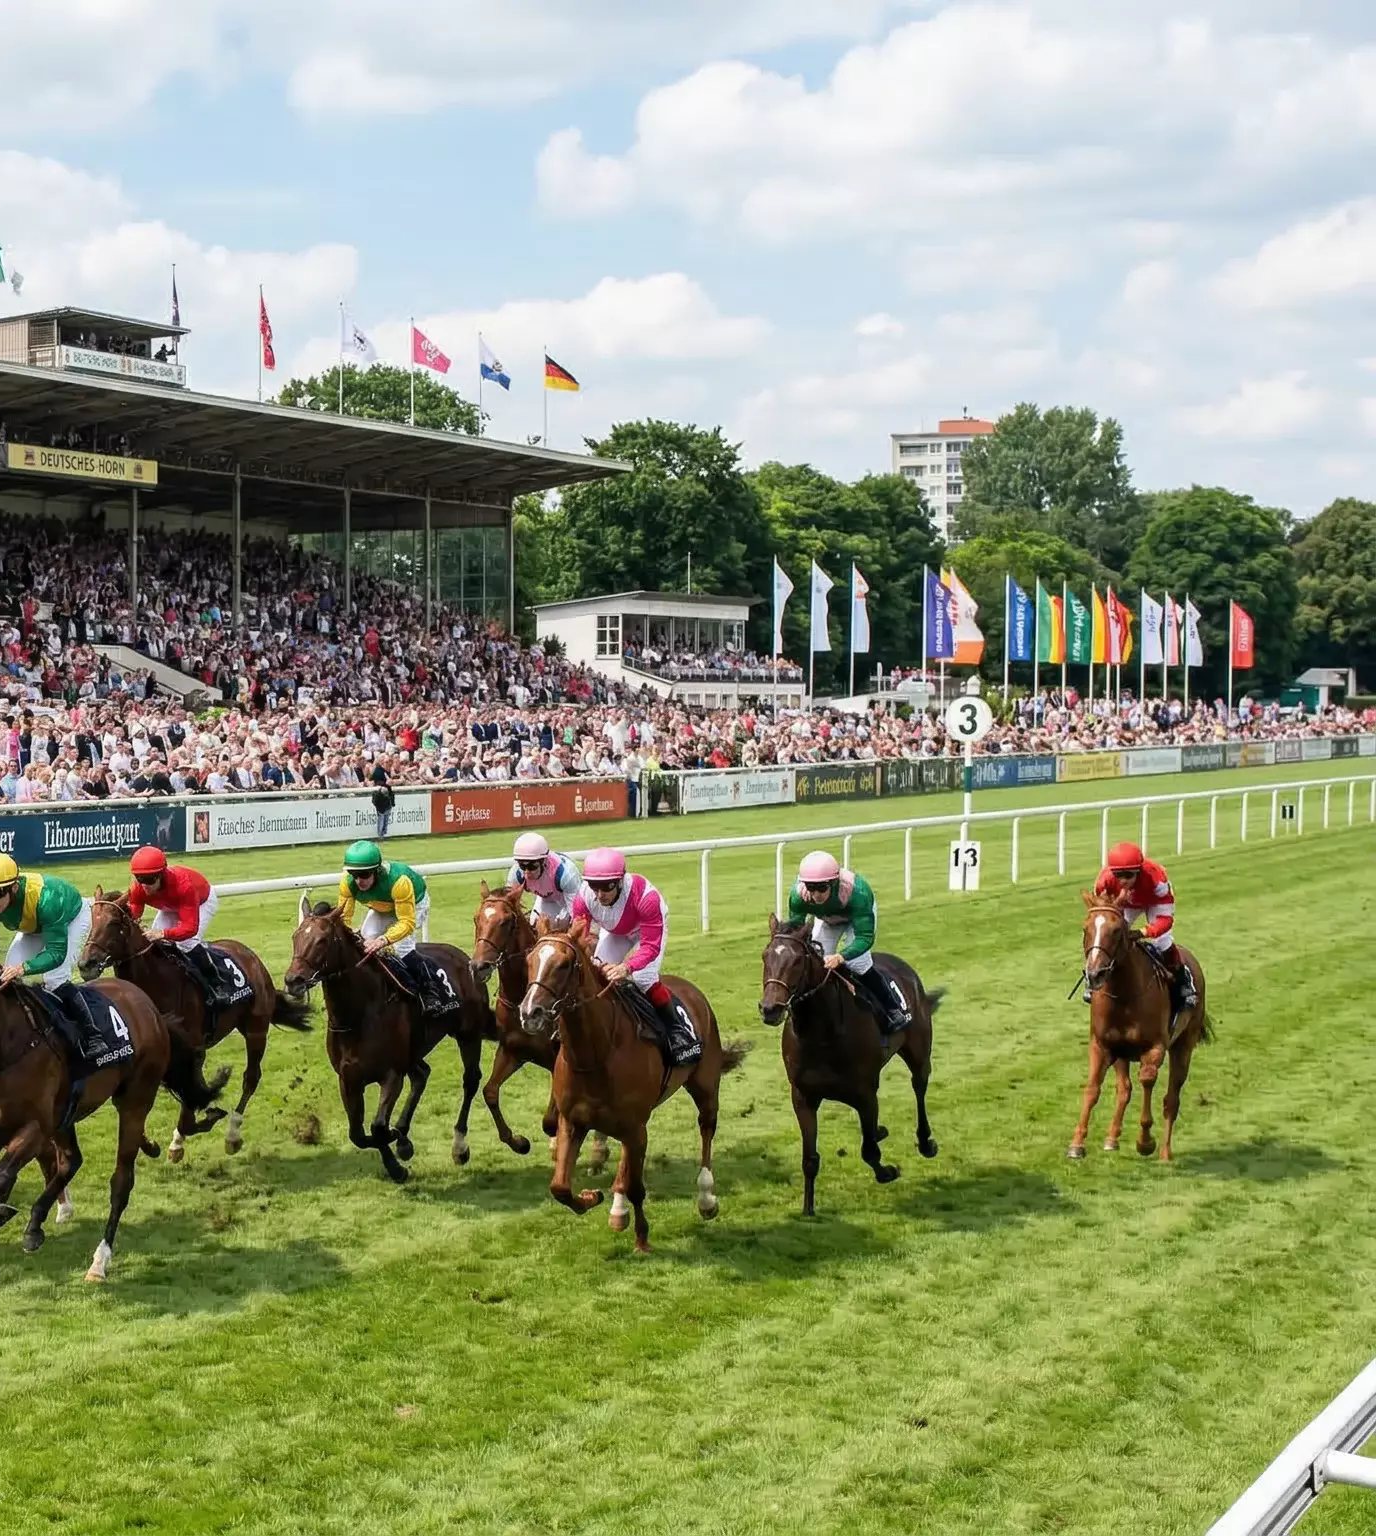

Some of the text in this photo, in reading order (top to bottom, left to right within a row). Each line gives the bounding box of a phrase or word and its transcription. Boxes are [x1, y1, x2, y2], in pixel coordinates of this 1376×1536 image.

[40, 451, 96, 473] DEUTSCHES
[959, 704, 977, 735] 3
[952, 847, 978, 867] 13
[223, 958, 246, 988] 3
[108, 1005, 130, 1041] 4
[676, 1005, 697, 1041] 3
